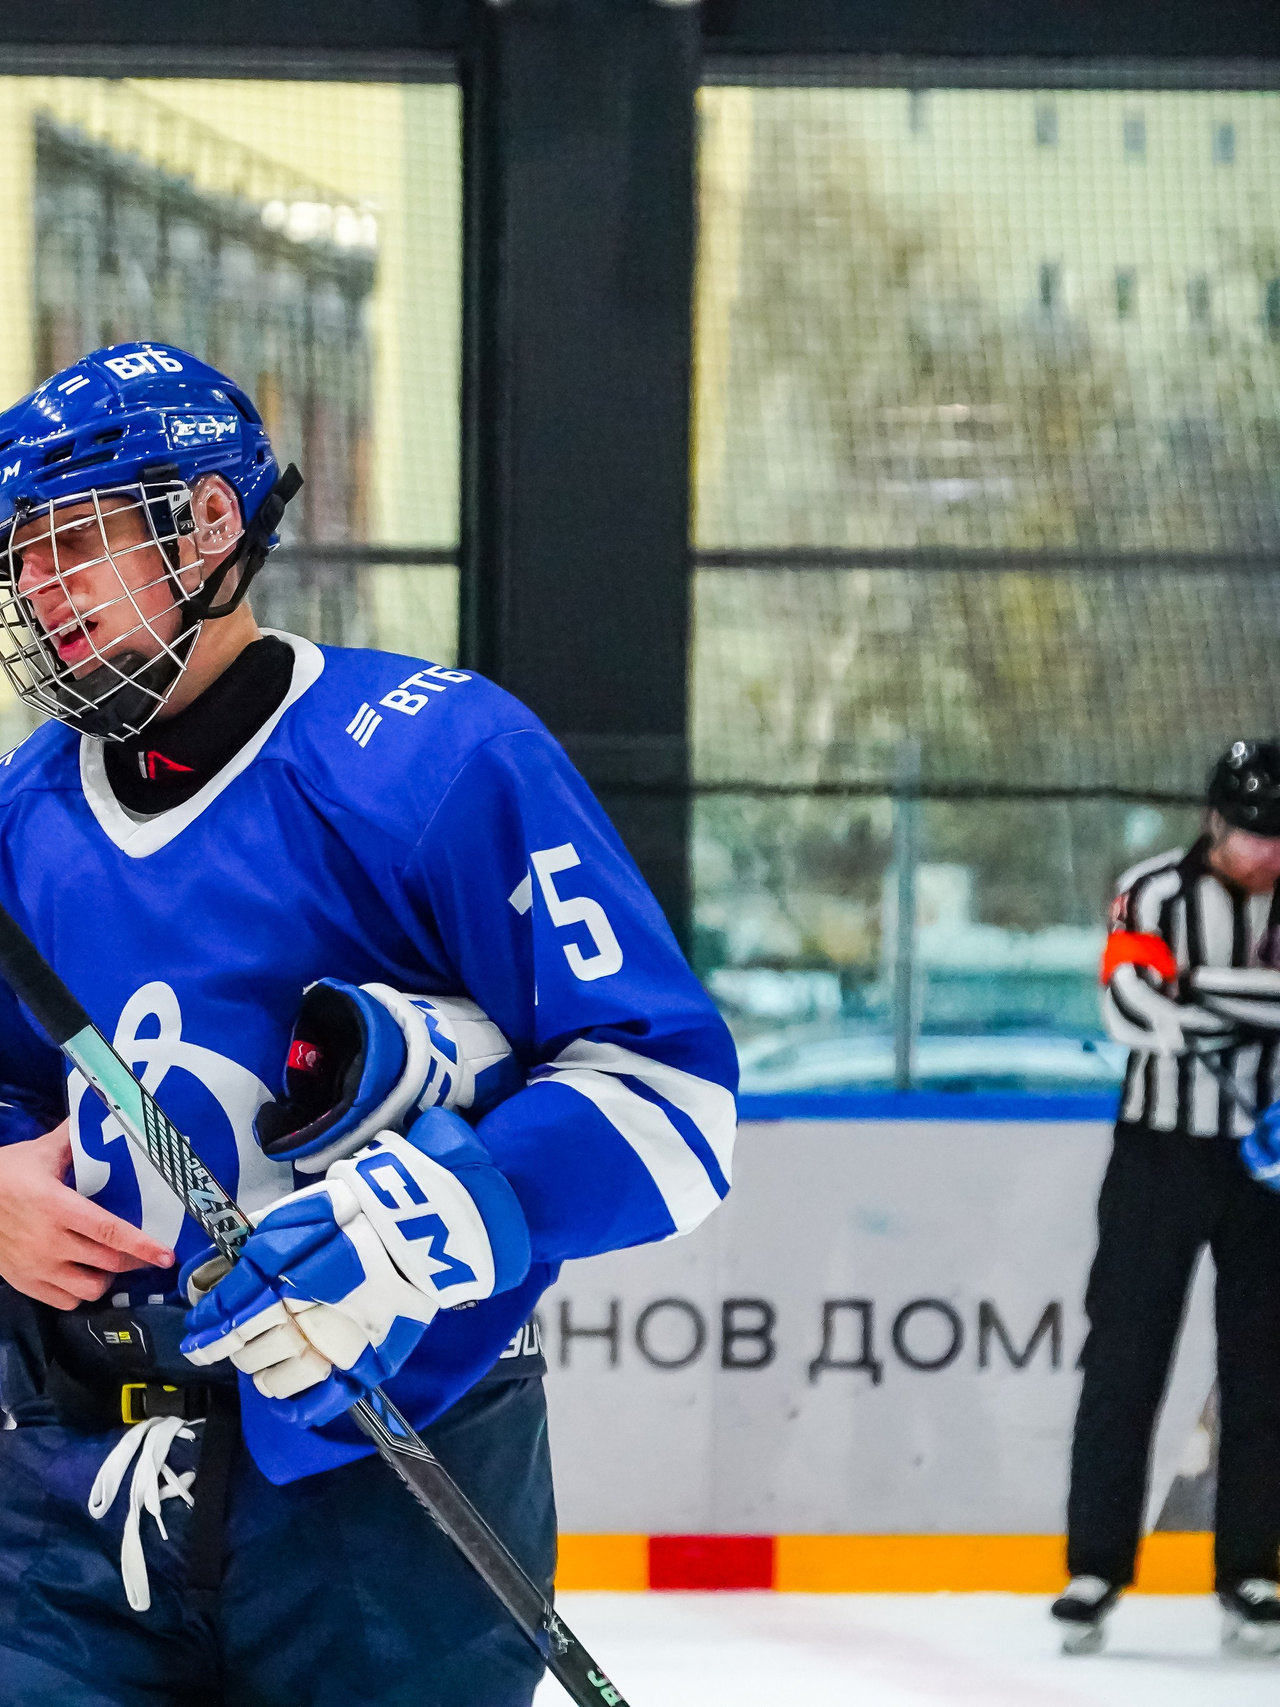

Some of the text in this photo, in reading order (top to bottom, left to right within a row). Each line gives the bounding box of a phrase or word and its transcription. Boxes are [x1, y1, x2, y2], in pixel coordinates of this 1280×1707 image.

[104, 349, 184, 381] ВТБ
[175, 415, 239, 436] CCM
[378, 665, 473, 717] ВТБ
